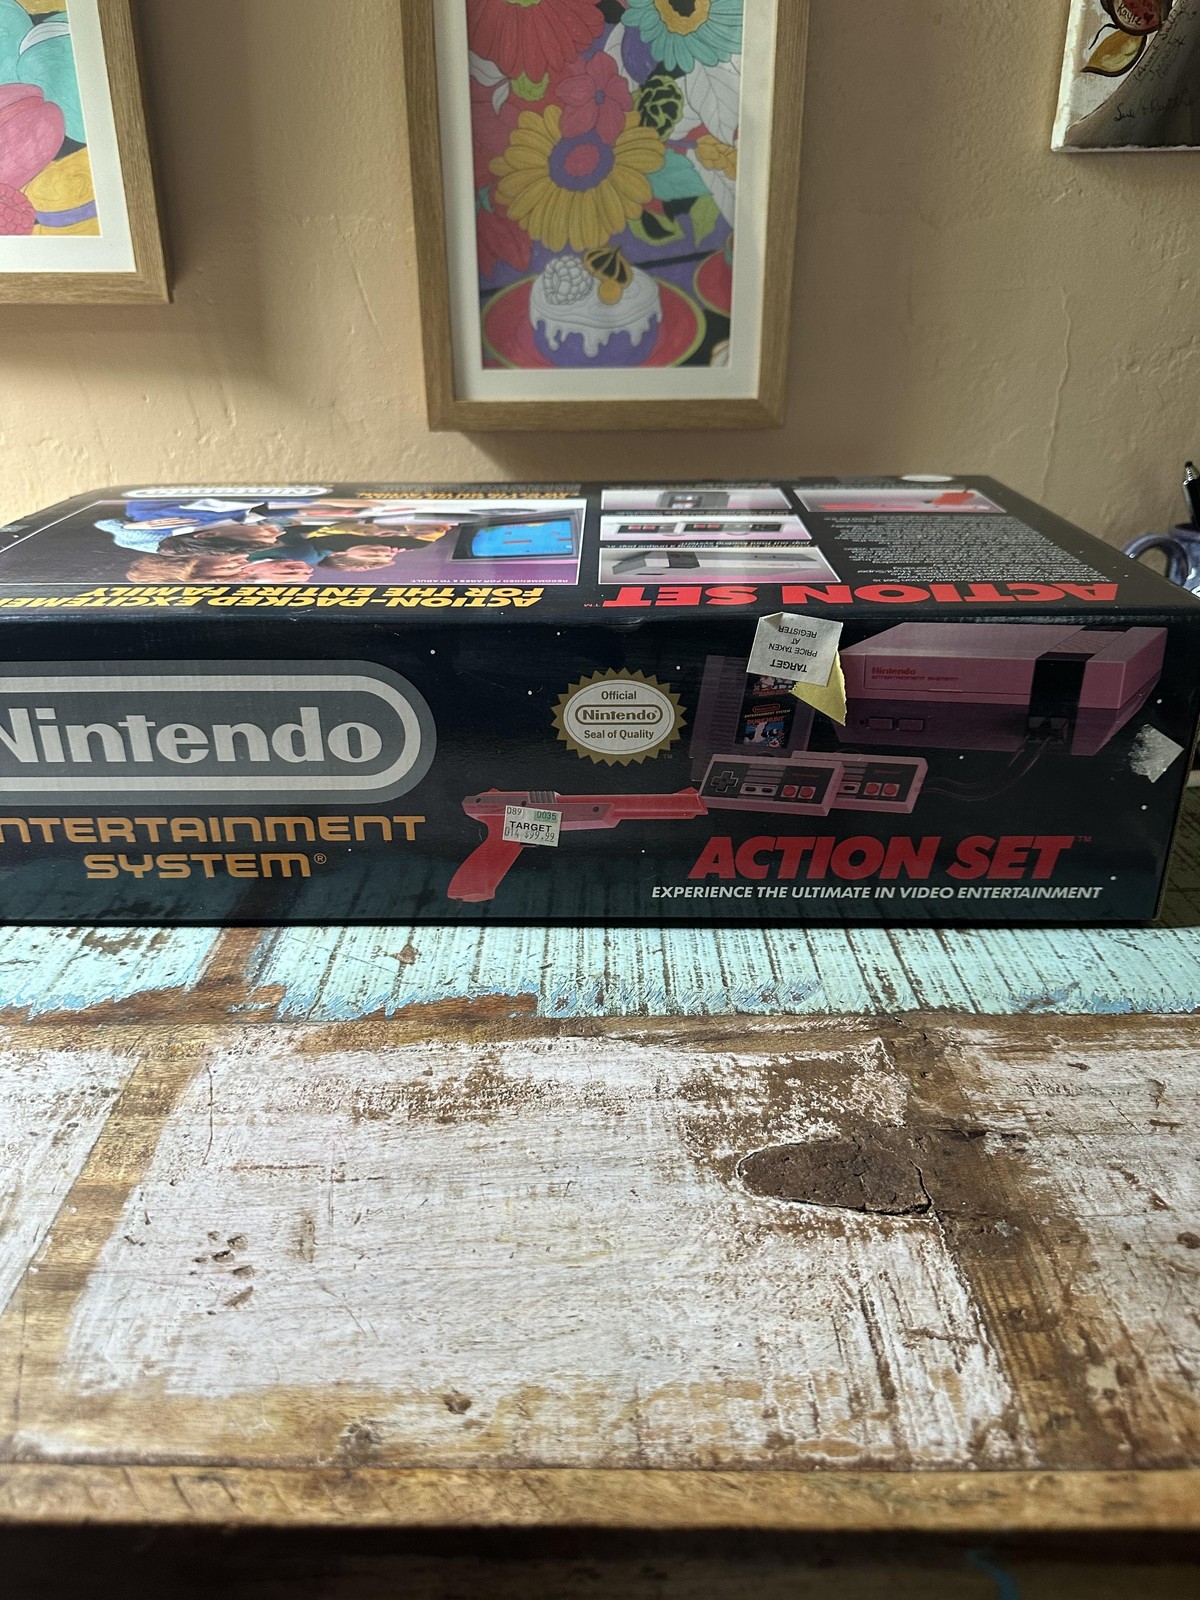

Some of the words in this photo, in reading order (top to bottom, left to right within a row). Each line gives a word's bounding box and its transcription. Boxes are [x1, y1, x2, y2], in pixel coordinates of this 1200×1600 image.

[77, 587, 230, 597] FAMILY
[231, 586, 377, 597] ENTIRE
[381, 587, 456, 597] THE
[464, 587, 545, 597] FOR
[602, 585, 758, 607] SET
[782, 583, 1119, 605] ACTION
[206, 596, 543, 607] ACTION-PACKED
[778, 625, 818, 639] REGISTER
[768, 642, 793, 654] TAKEN
[794, 647, 818, 658] PRICE
[770, 659, 808, 673] TARGET
[872, 667, 916, 675] Nintendo
[601, 690, 637, 700] Official
[582, 709, 657, 721] Nintendo
[584, 729, 605, 739] Seal
[607, 729, 617, 739] of
[619, 729, 655, 740] Quality
[0, 815, 426, 843] NTERTAINMENT
[509, 820, 552, 833] TARGET
[687, 835, 942, 880] ACTION
[945, 835, 1076, 880] SET
[651, 886, 753, 899] EXPERIENCE
[757, 886, 788, 899] THE
[791, 886, 871, 899] ULTIMATE
[874, 886, 896, 899] IN
[900, 886, 954, 899] VIDEO
[957, 886, 1104, 899] ENTERTAINMENT
